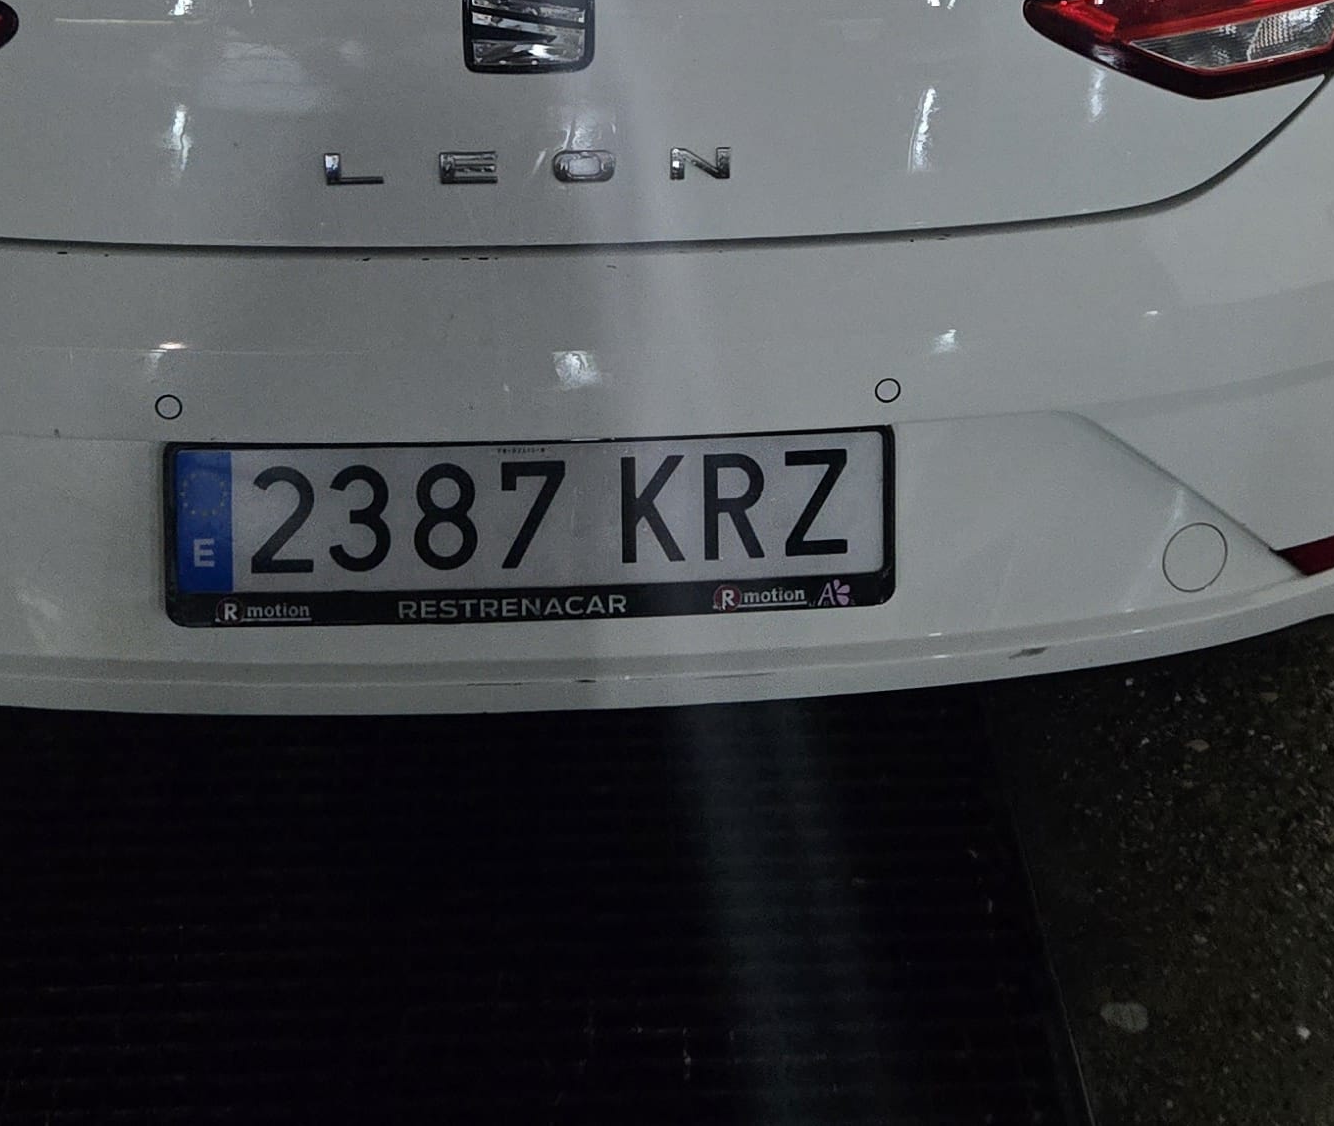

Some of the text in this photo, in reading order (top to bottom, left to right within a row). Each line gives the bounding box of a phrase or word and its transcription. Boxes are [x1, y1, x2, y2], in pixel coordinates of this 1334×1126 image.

[323, 146, 732, 186] LEON
[250, 448, 849, 575] 2387 KRZ
[193, 537, 216, 568] E
[398, 594, 628, 620] RESTRENACAR
